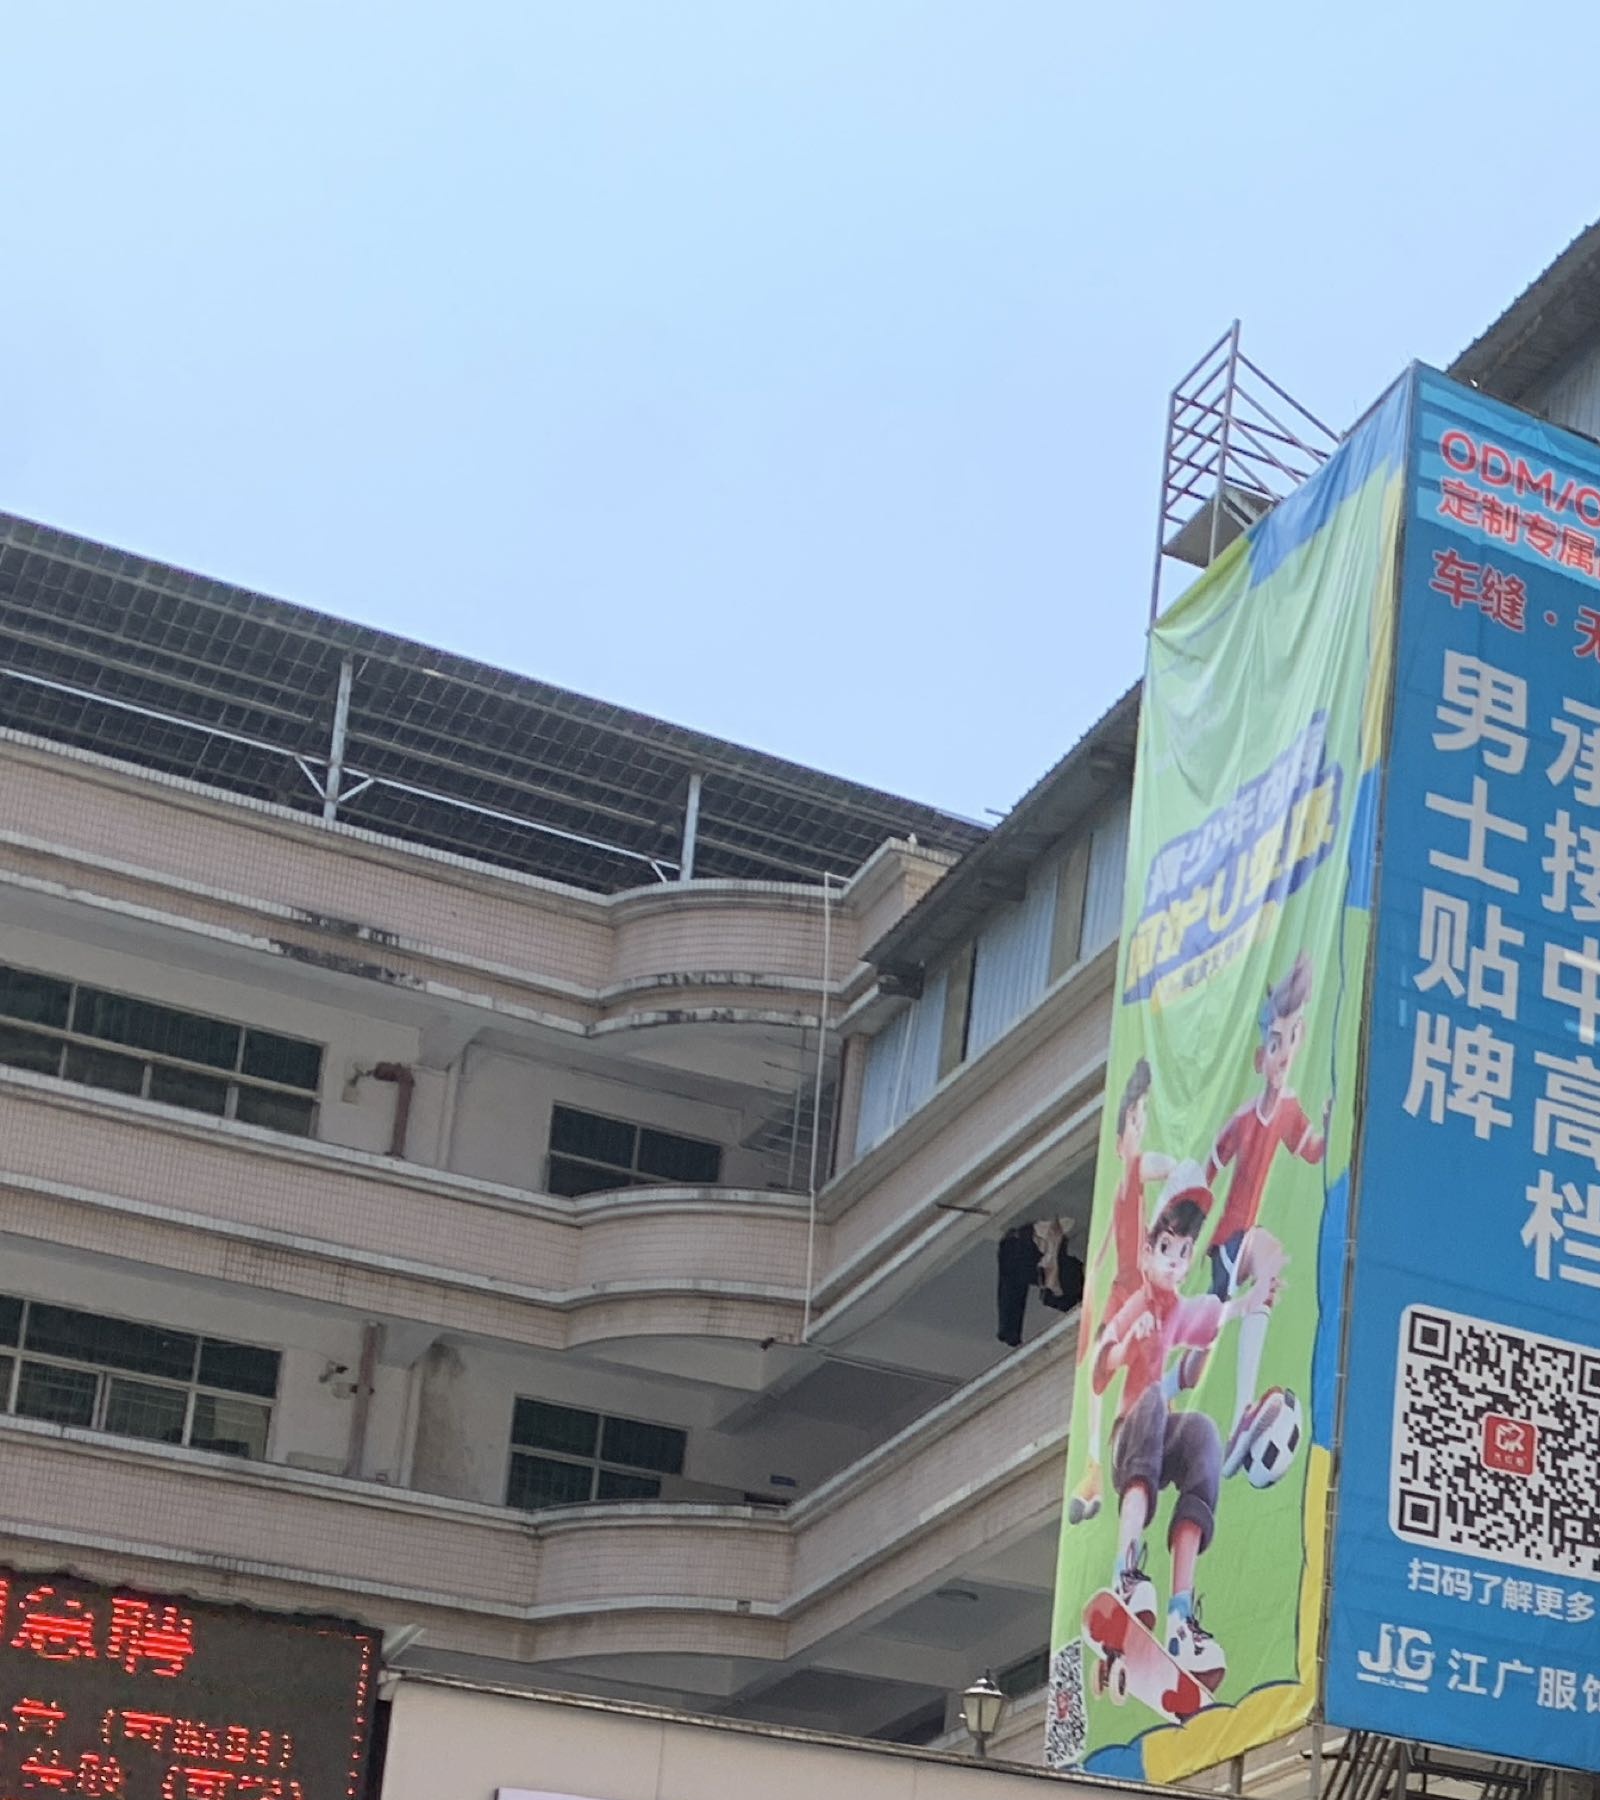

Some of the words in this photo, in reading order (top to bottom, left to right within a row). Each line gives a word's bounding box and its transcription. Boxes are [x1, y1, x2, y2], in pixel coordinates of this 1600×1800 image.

[1403, 649, 1527, 1139] 男士贴牌
[1406, 1558, 1597, 1624] 扫码了解更多
[1358, 1623, 1436, 1681] JG
